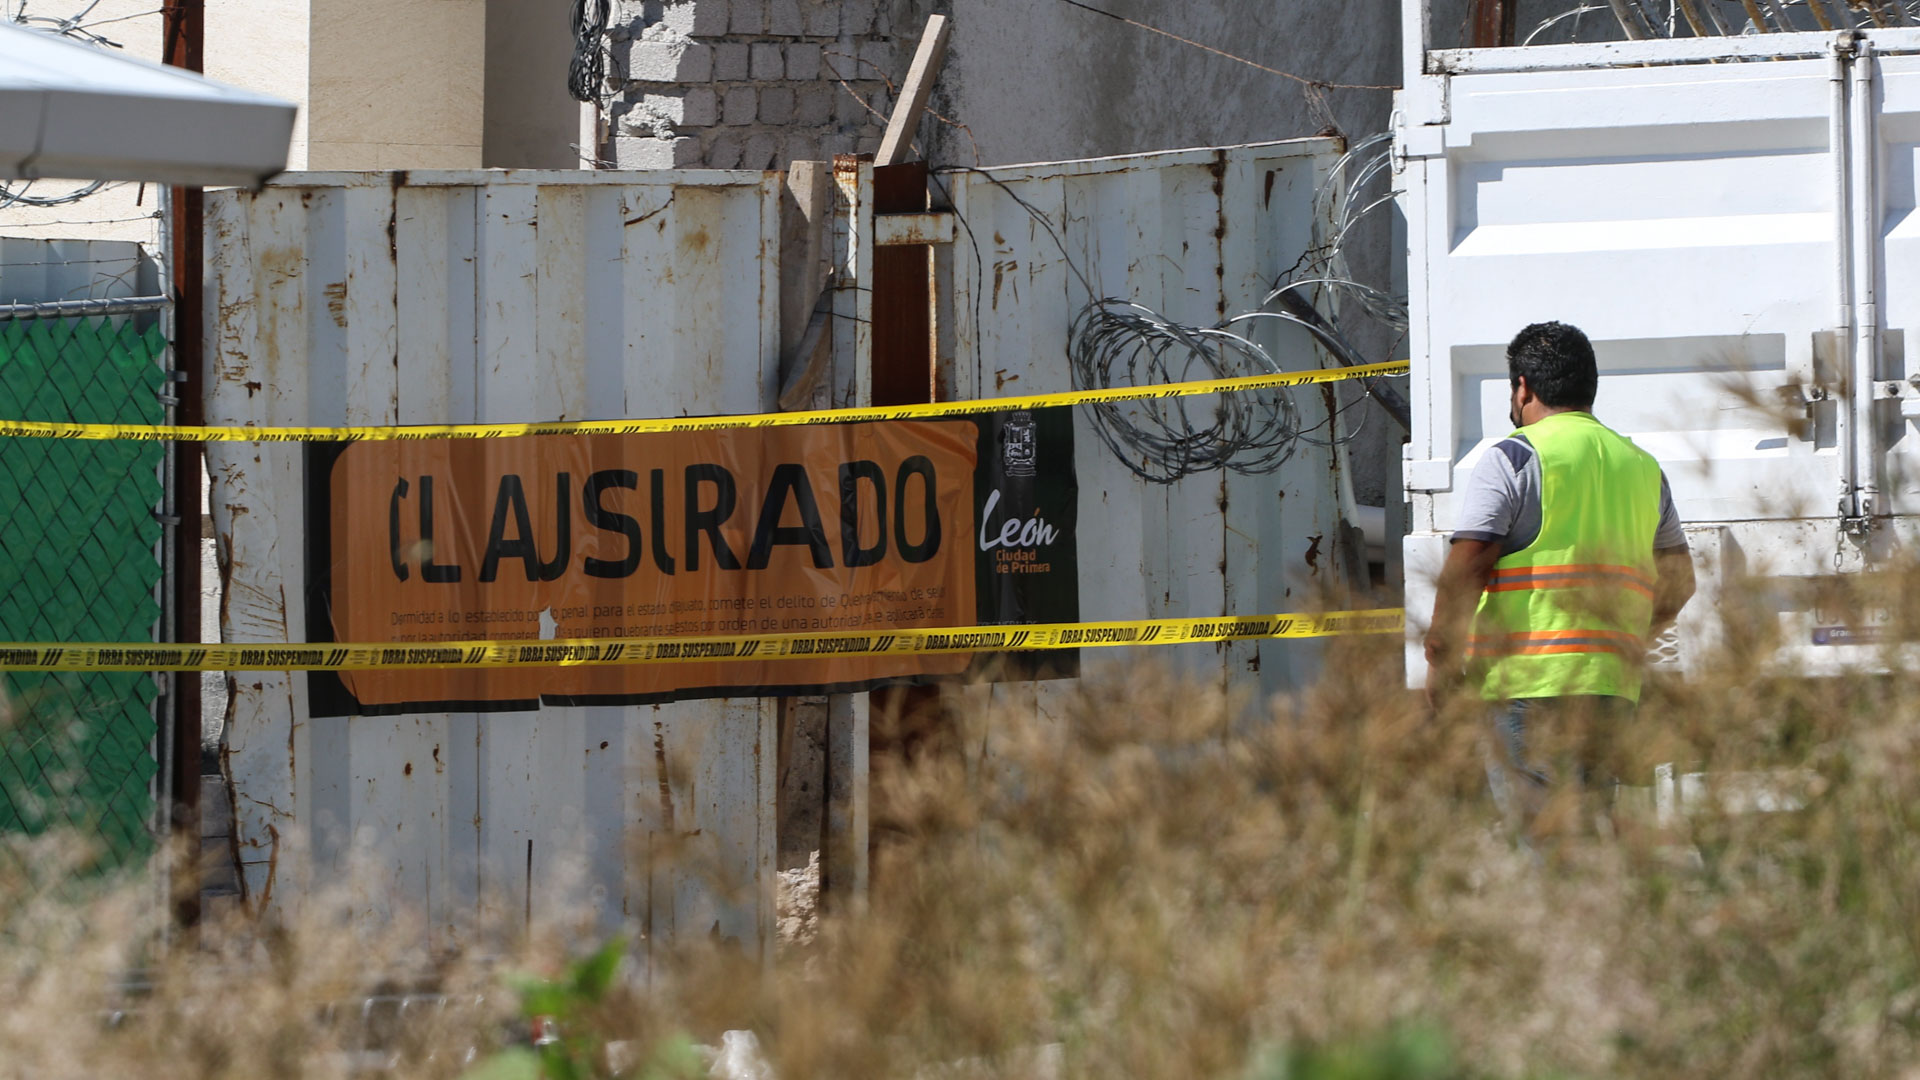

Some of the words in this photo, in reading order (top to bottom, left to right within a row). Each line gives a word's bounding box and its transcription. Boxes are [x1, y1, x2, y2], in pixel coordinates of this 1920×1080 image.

[980, 489, 1059, 551] León
[996, 549, 1036, 561] Ciudad
[996, 562, 1009, 573] de
[1011, 562, 1050, 573] Primera
[593, 606, 623, 621] para
[759, 595, 771, 609] el
[777, 595, 815, 609] delito
[820, 594, 836, 608] de
[719, 617, 757, 631] orden
[761, 616, 778, 630] de
[782, 617, 808, 629] una
[1190, 623, 1215, 638] OBRA
[1216, 621, 1270, 637] SUSPENDIDA
[925, 634, 950, 650] OBRA
[950, 632, 1006, 649] SUSPENDIDA
[1059, 629, 1082, 644] OBRA
[1083, 627, 1138, 642] SUSPENDIDA
[519, 646, 543, 662] OBRA
[544, 645, 600, 661] SUSPENDIDA
[656, 643, 680, 658] OBRA
[681, 642, 736, 658] SUSPENDIDA
[790, 639, 815, 654] OBRA
[815, 637, 871, 653] SUSPENDIDA
[98, 649, 122, 665] OBRA
[124, 649, 182, 665] SUSPENDIDA
[240, 650, 265, 665] OBRA
[266, 650, 323, 666] SUSPENDIDA
[381, 649, 406, 664] OBRA
[407, 648, 463, 664] SUSPENDIDA
